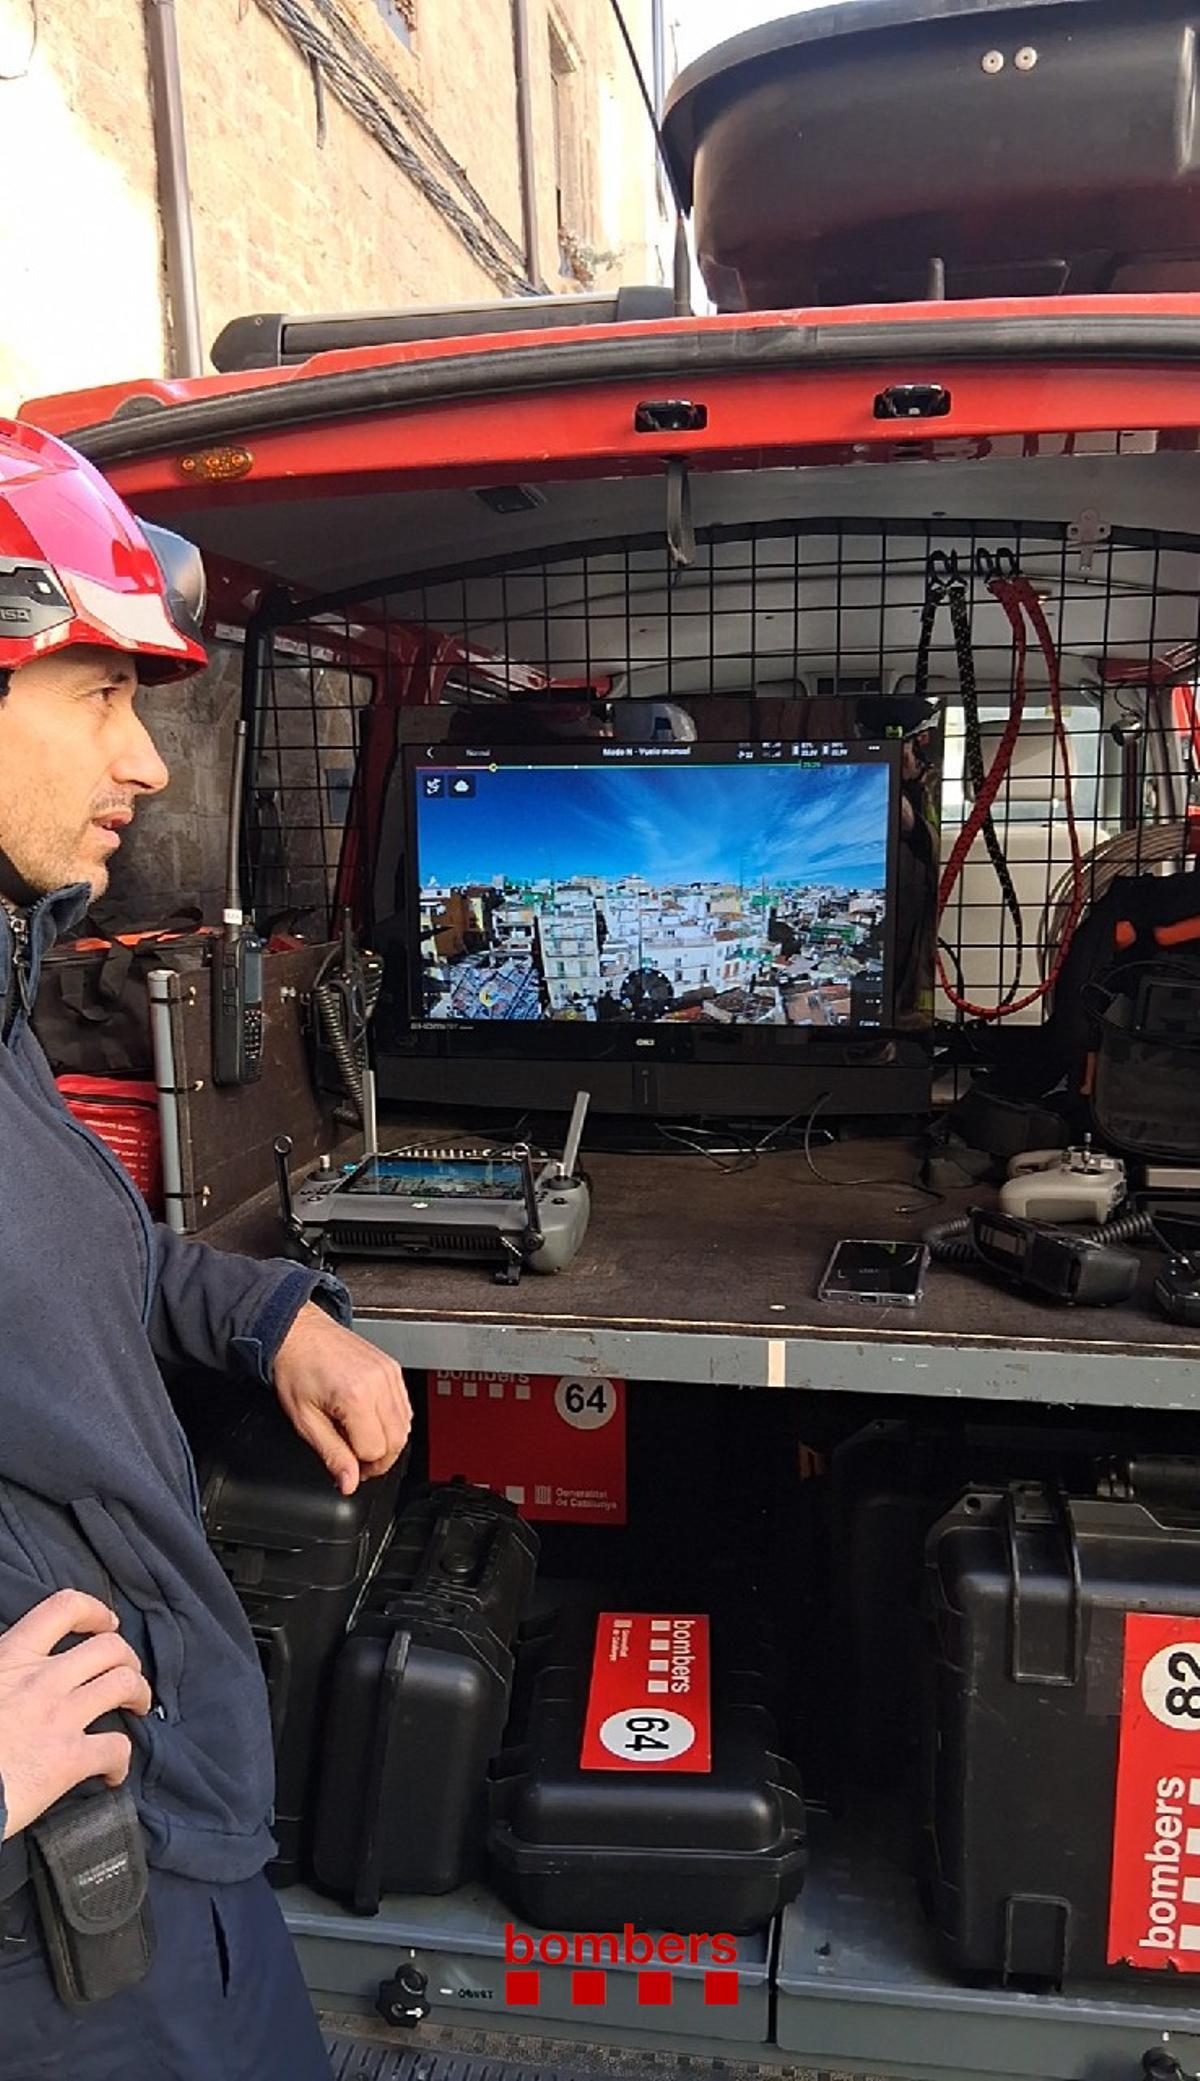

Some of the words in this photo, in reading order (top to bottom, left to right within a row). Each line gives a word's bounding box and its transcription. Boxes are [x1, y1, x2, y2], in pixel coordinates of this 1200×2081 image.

[565, 1384, 607, 1414] 64
[671, 1620, 696, 1693] bombers
[1165, 1651, 1200, 1719] 82
[625, 1717, 670, 1752] 64
[1139, 1776, 1186, 1949] bombers
